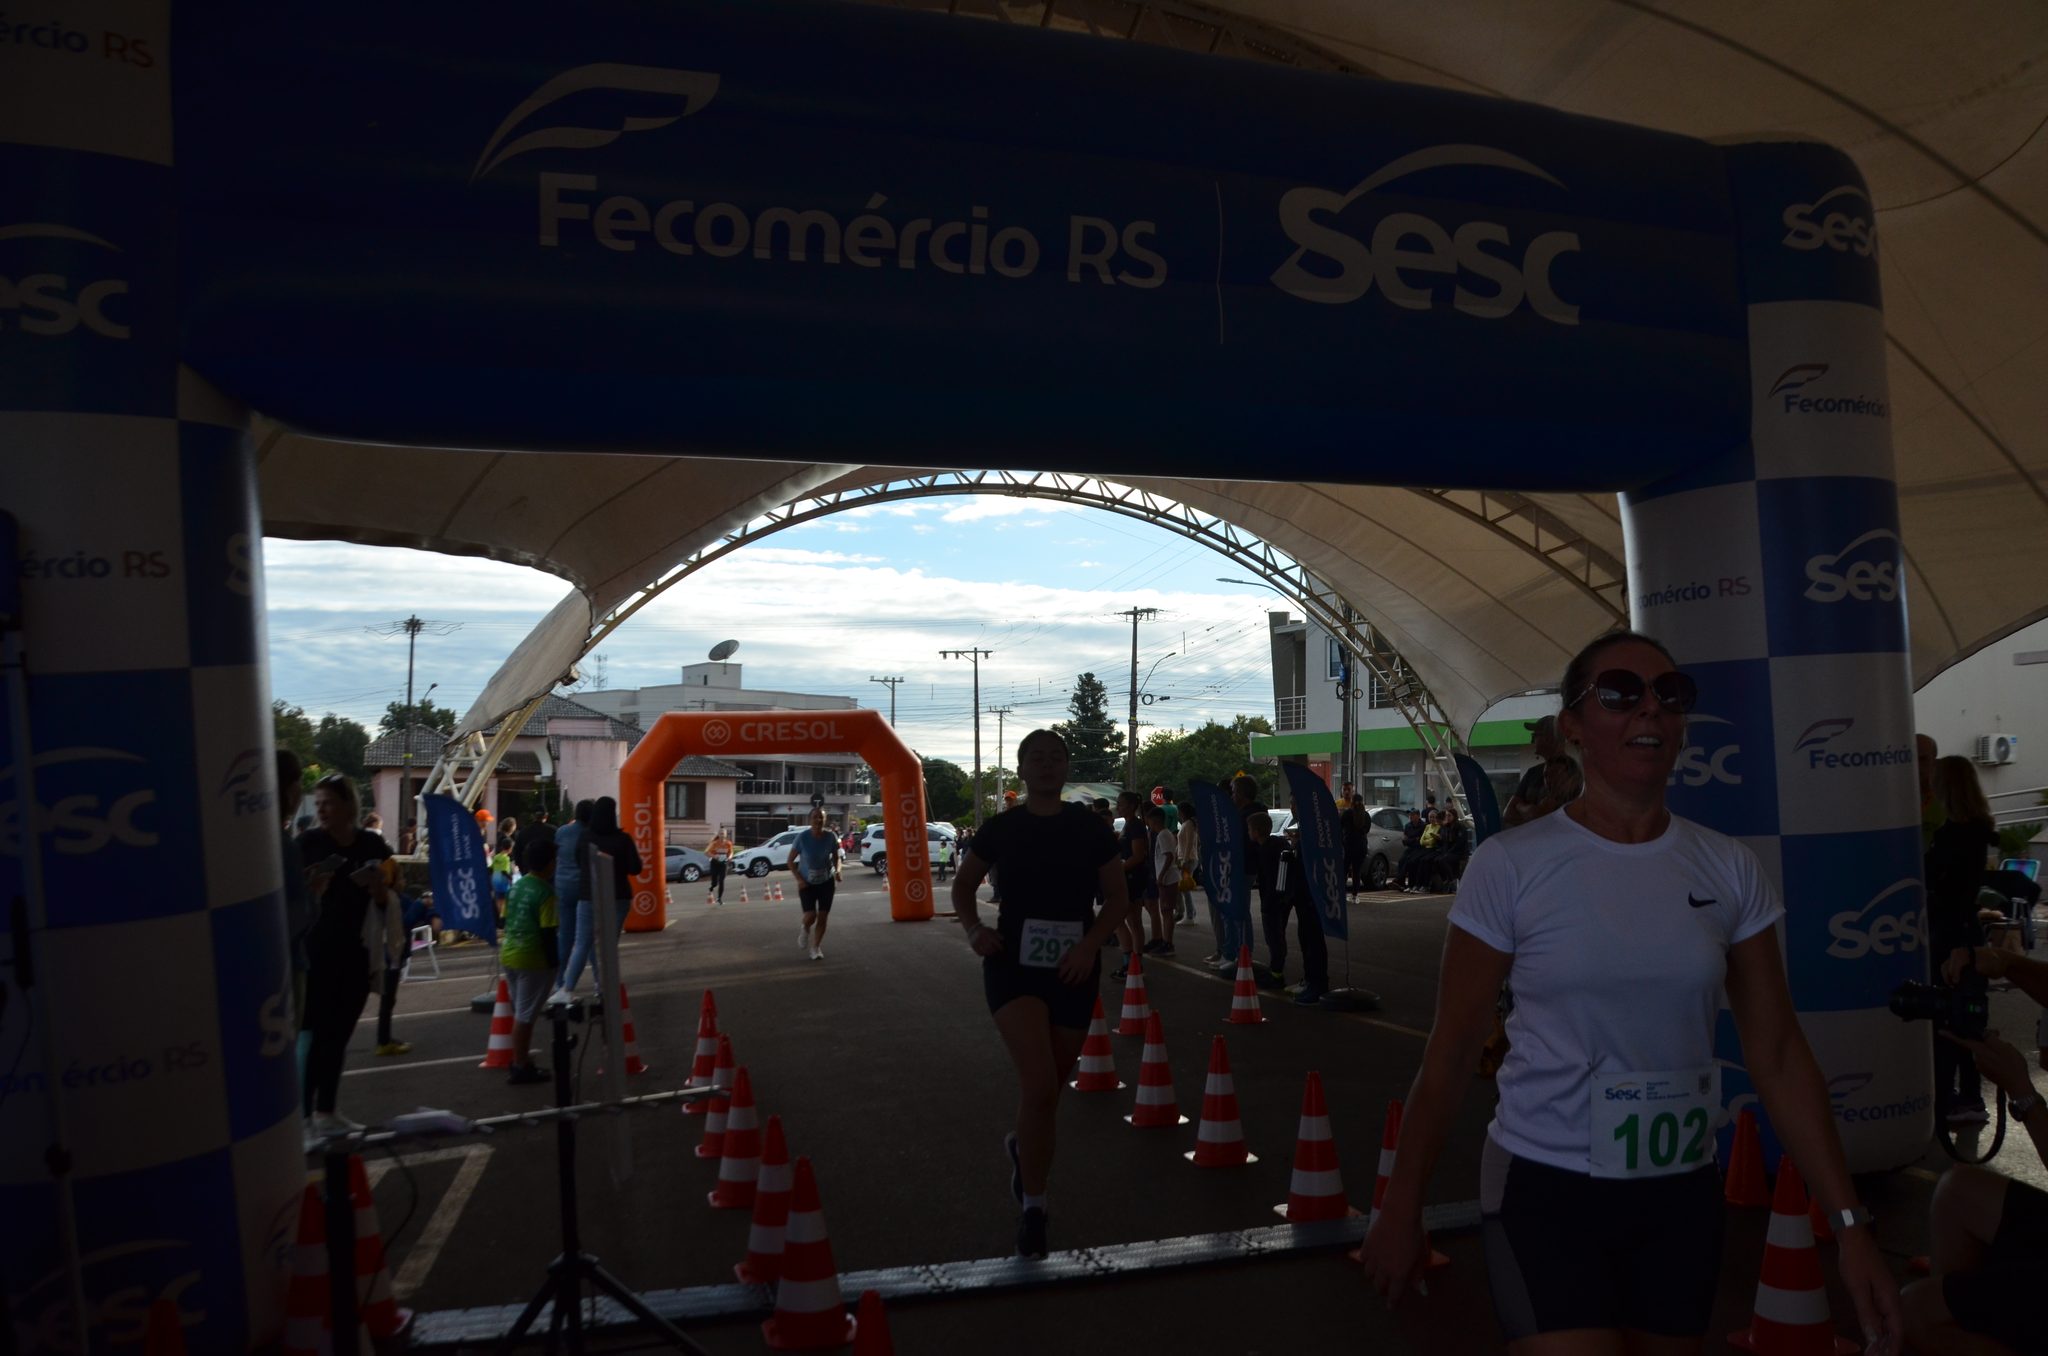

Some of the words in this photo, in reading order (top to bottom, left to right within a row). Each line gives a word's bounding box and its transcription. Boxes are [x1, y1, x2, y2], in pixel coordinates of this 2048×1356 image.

[103, 31, 155, 68] RS
[538, 172, 1041, 279] Fecomércio
[1067, 213, 1169, 290] RS
[1269, 184, 1582, 326] Sesc
[123, 549, 171, 578] RS
[1717, 576, 1753, 598] RS
[739, 719, 844, 743] CRESOL
[900, 785, 919, 873] CRESOL
[456, 866, 481, 921] Sesc
[1215, 850, 1232, 904] Sesc
[1322, 857, 1342, 921] Sesc
[1604, 1086, 1642, 1101] Sesc
[1613, 1106, 1709, 1170] 102
